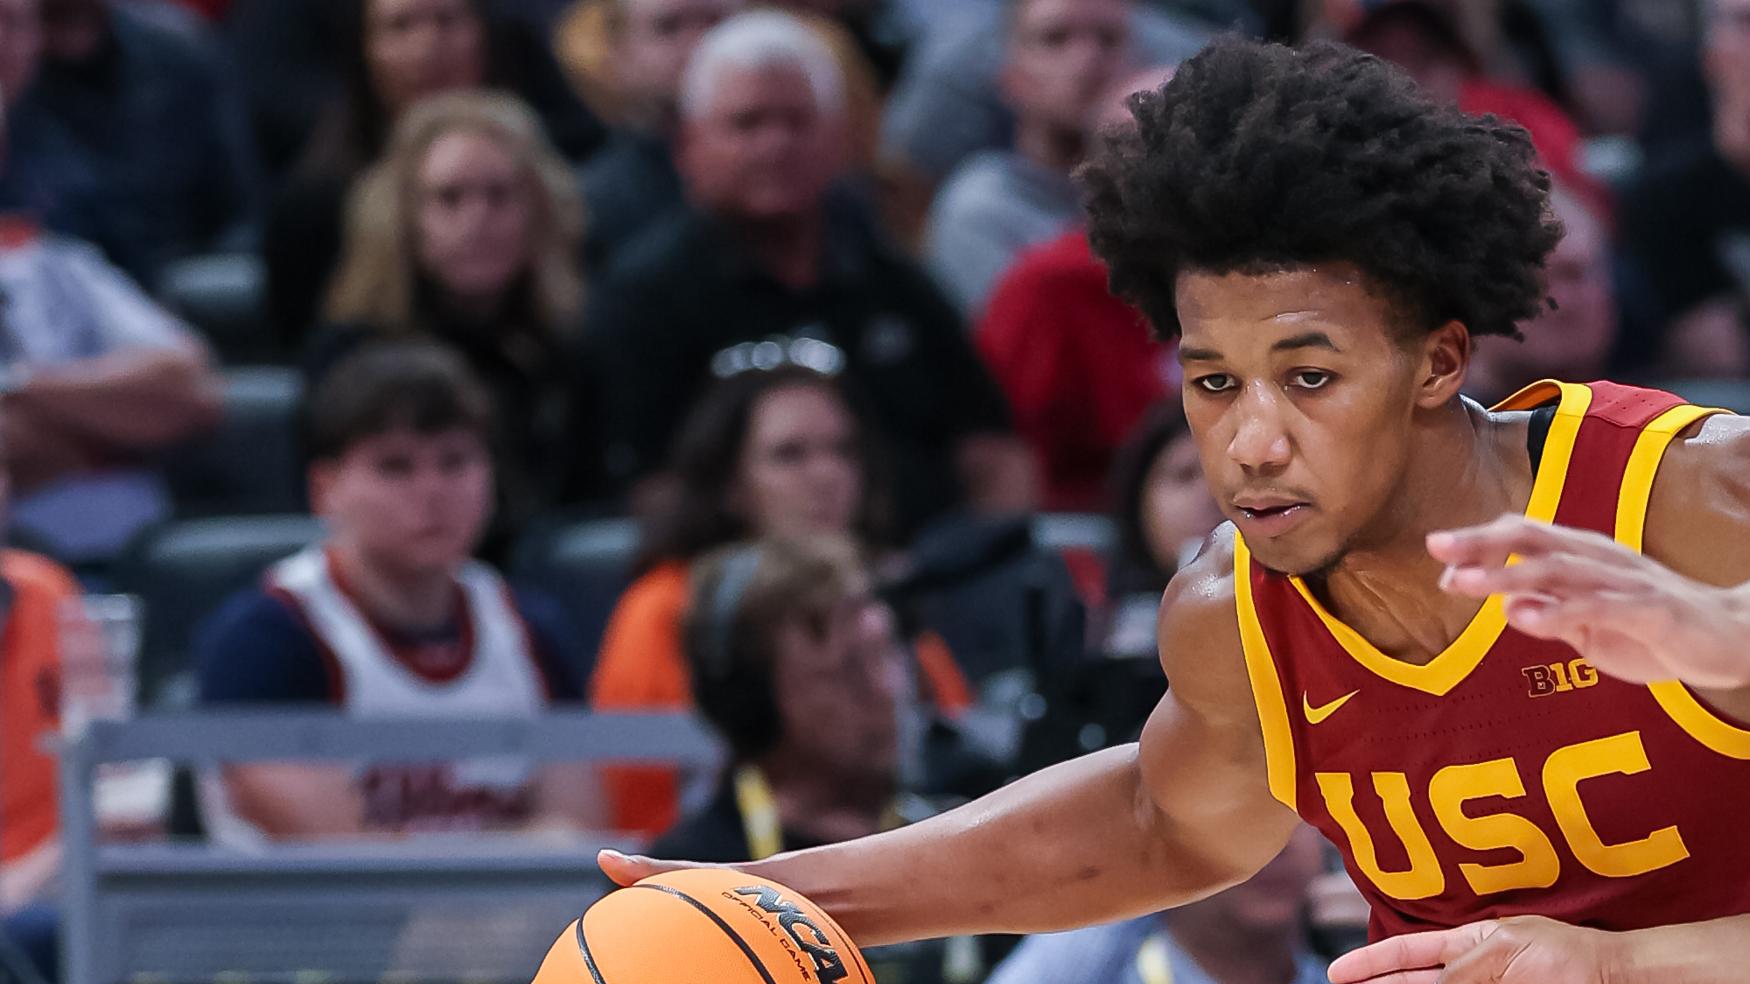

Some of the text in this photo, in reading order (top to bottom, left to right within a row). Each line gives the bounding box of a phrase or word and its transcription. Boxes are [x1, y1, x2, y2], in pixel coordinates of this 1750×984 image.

[1314, 730, 1690, 900] USC
[721, 891, 778, 937] OFFICIAL
[779, 938, 812, 982] GAME
